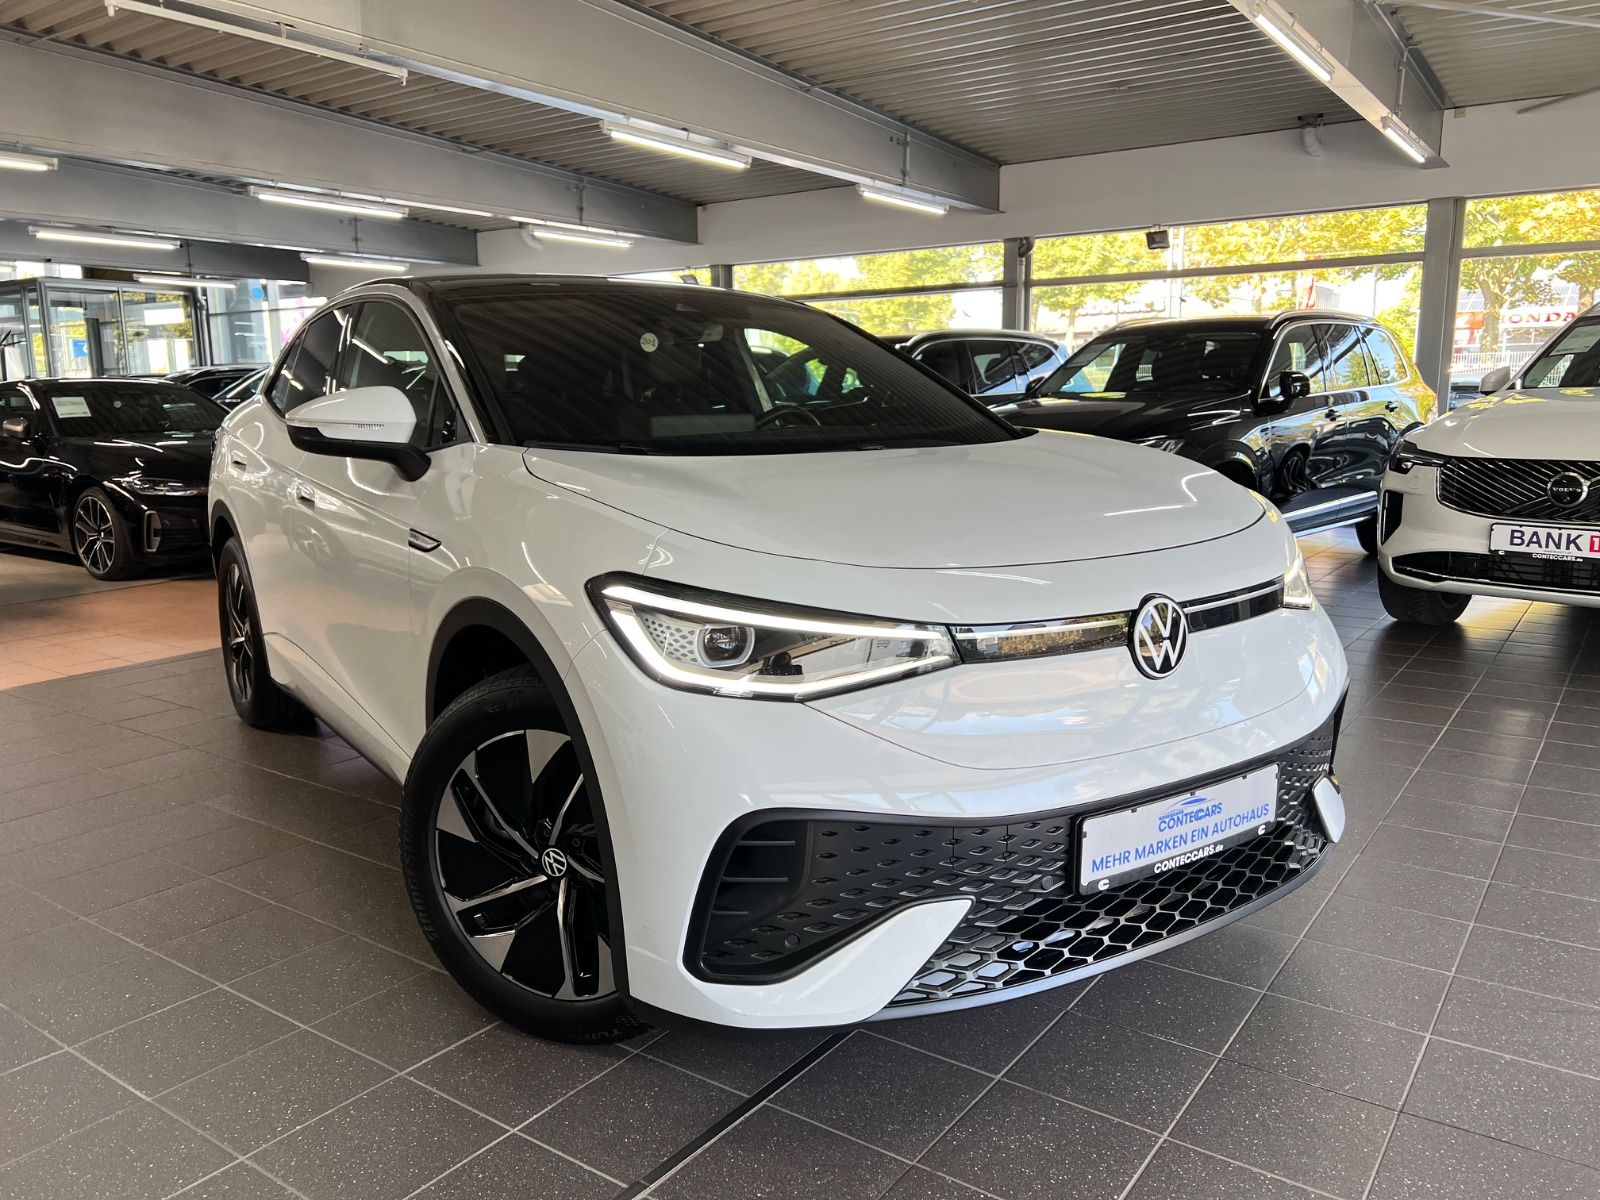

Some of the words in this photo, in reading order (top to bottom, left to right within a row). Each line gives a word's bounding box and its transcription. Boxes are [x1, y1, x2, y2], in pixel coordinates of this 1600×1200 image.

[1502, 311, 1577, 324] ONDA
[1509, 529, 1584, 552] BANK
[1532, 553, 1583, 562] CONTECCARS.de
[1135, 599, 1188, 677] VW
[1158, 802, 1222, 832] CONTECCARS
[1091, 850, 1131, 873] MEHR
[1134, 832, 1188, 861] MARKEN
[1190, 826, 1209, 843] EIN
[1211, 803, 1270, 835] AUTOHAUS
[1153, 843, 1224, 874] CONTECCARS.de
